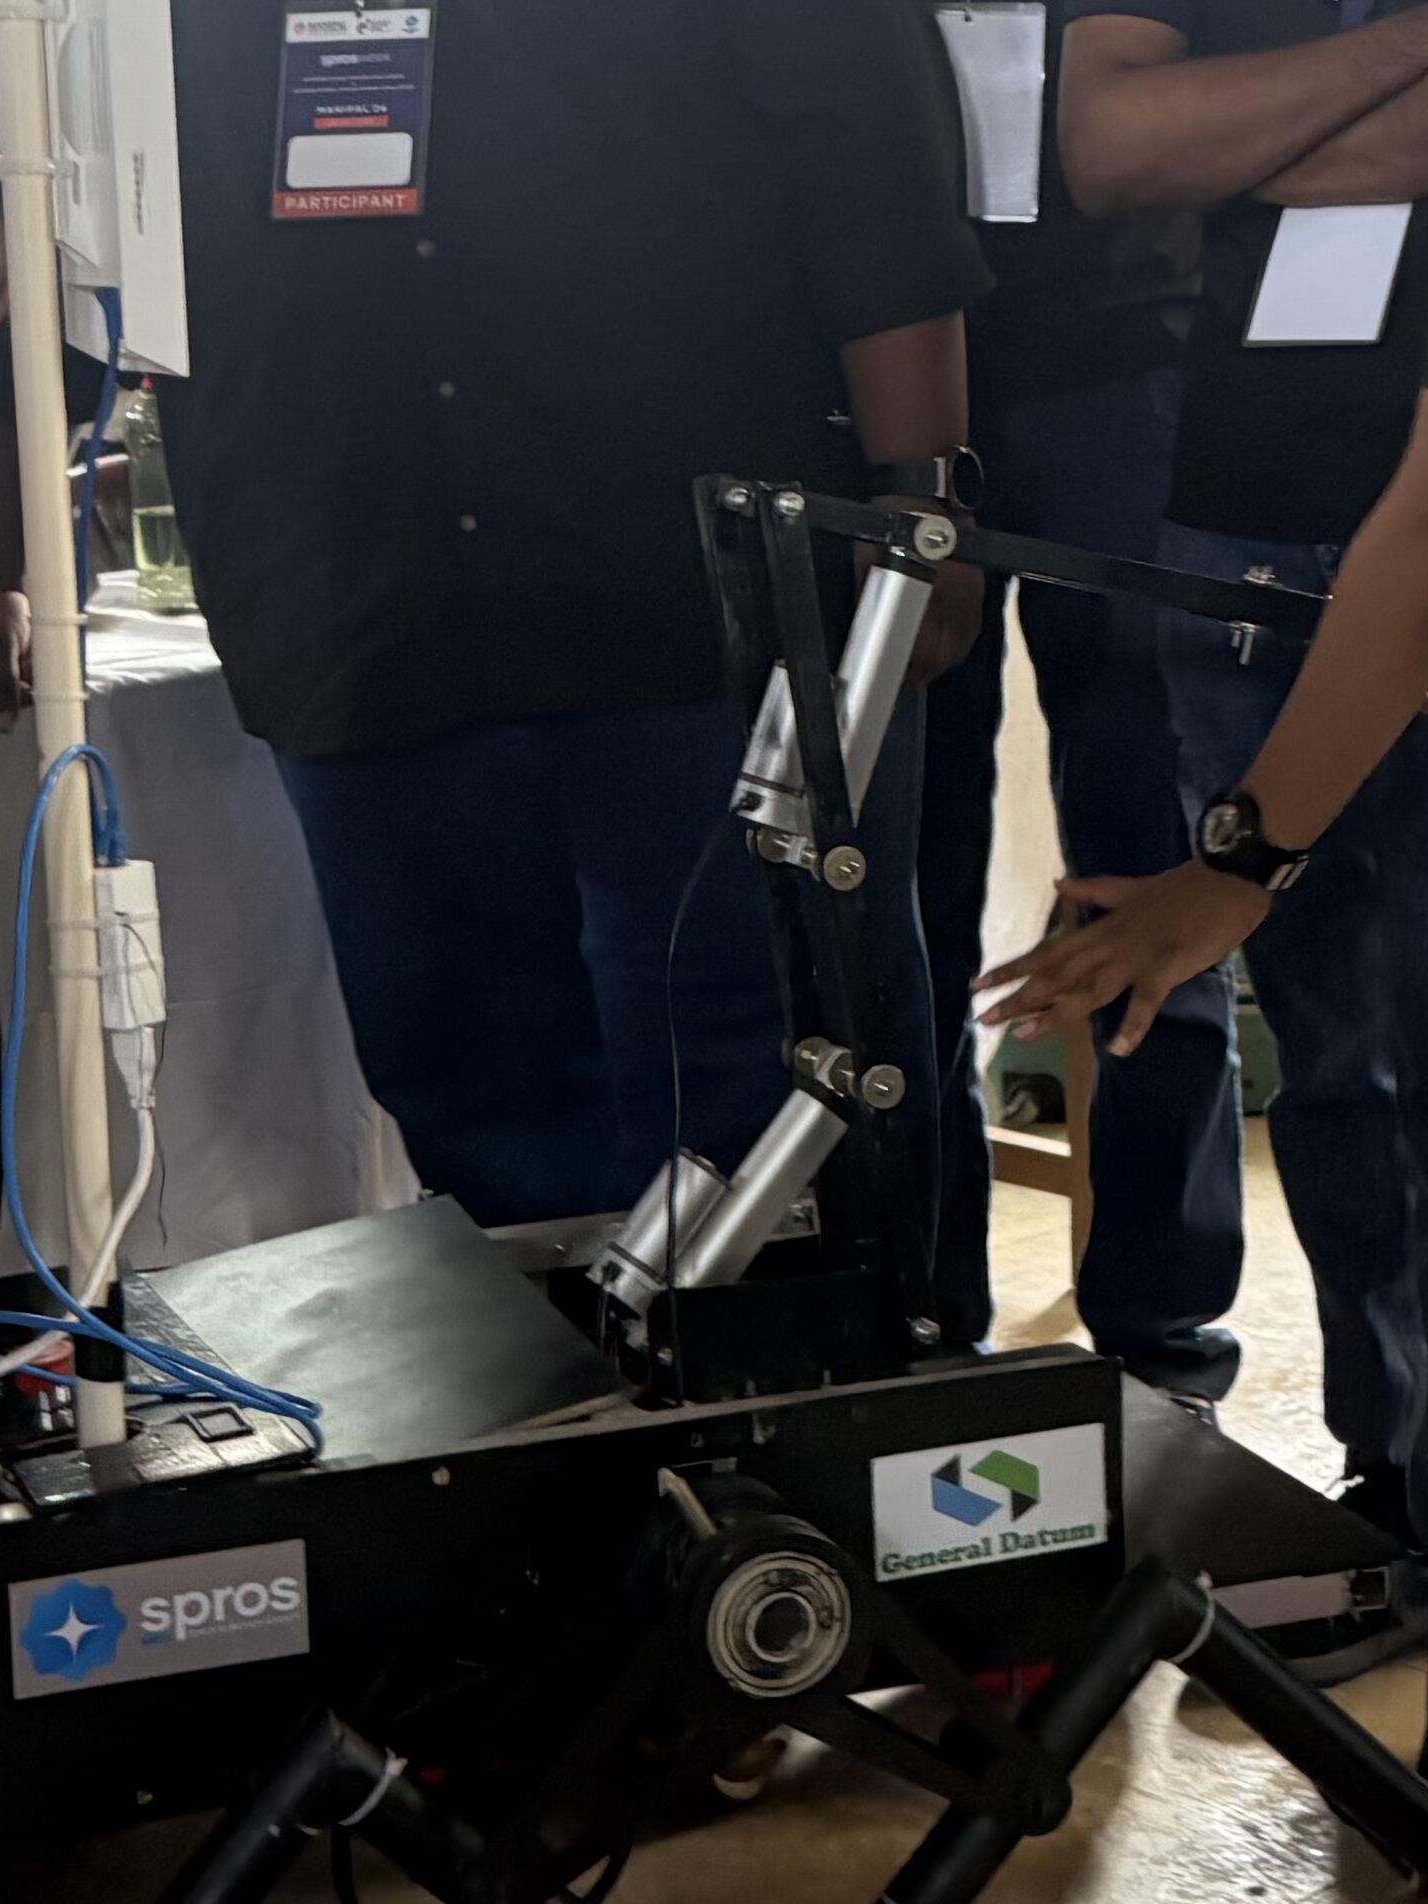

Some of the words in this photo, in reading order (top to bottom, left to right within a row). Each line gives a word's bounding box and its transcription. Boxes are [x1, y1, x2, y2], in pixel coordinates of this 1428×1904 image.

[285, 194, 405, 210] PARTICIPANT
[881, 1536, 992, 1574] General
[999, 1523, 1096, 1553] Datum
[139, 1576, 301, 1641] spros
